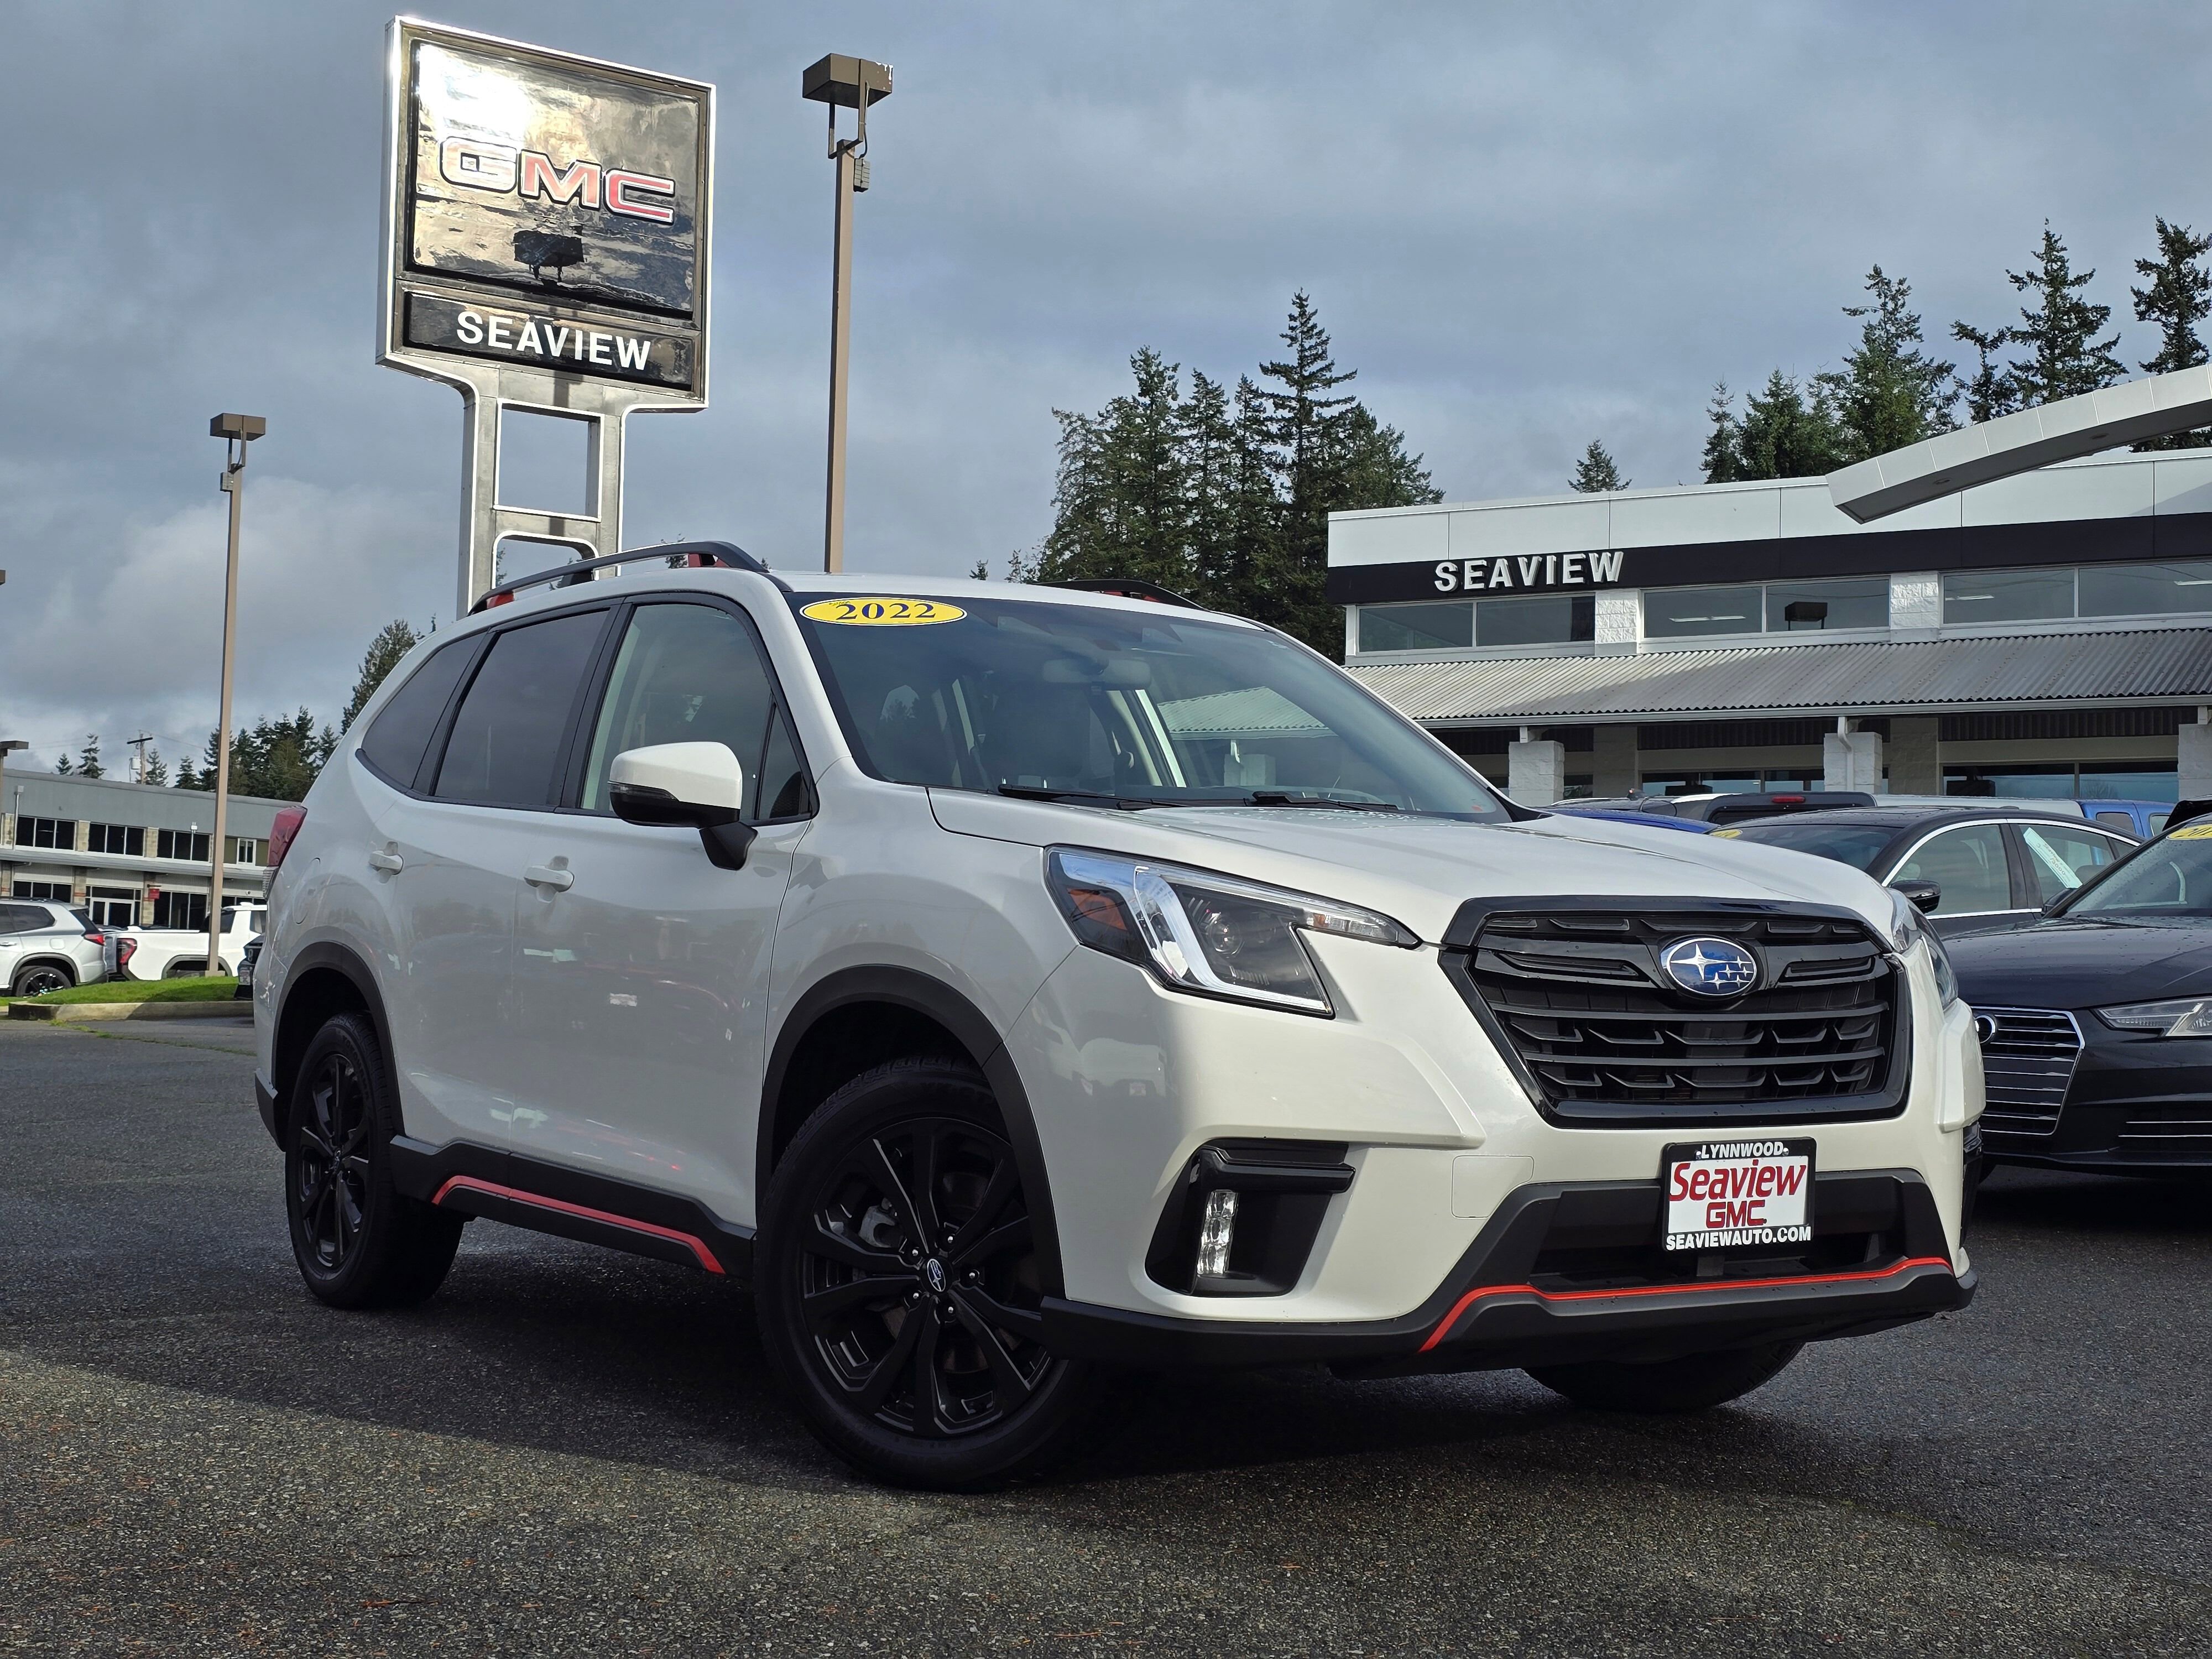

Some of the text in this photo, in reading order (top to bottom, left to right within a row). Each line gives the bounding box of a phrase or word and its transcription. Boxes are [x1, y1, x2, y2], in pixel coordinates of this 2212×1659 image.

[440, 136, 676, 226] GMC
[457, 310, 651, 371] SEAVIEW
[1434, 551, 1624, 592] SEAVIEW
[835, 603, 936, 620] 2022
[1701, 1141, 1784, 1159] LYNNWOOD
[1669, 1159, 1807, 1202] Seaview
[1706, 1199, 1766, 1229] GMC
[1666, 1226, 1811, 1251] SEAVIEWAUTO.COM
